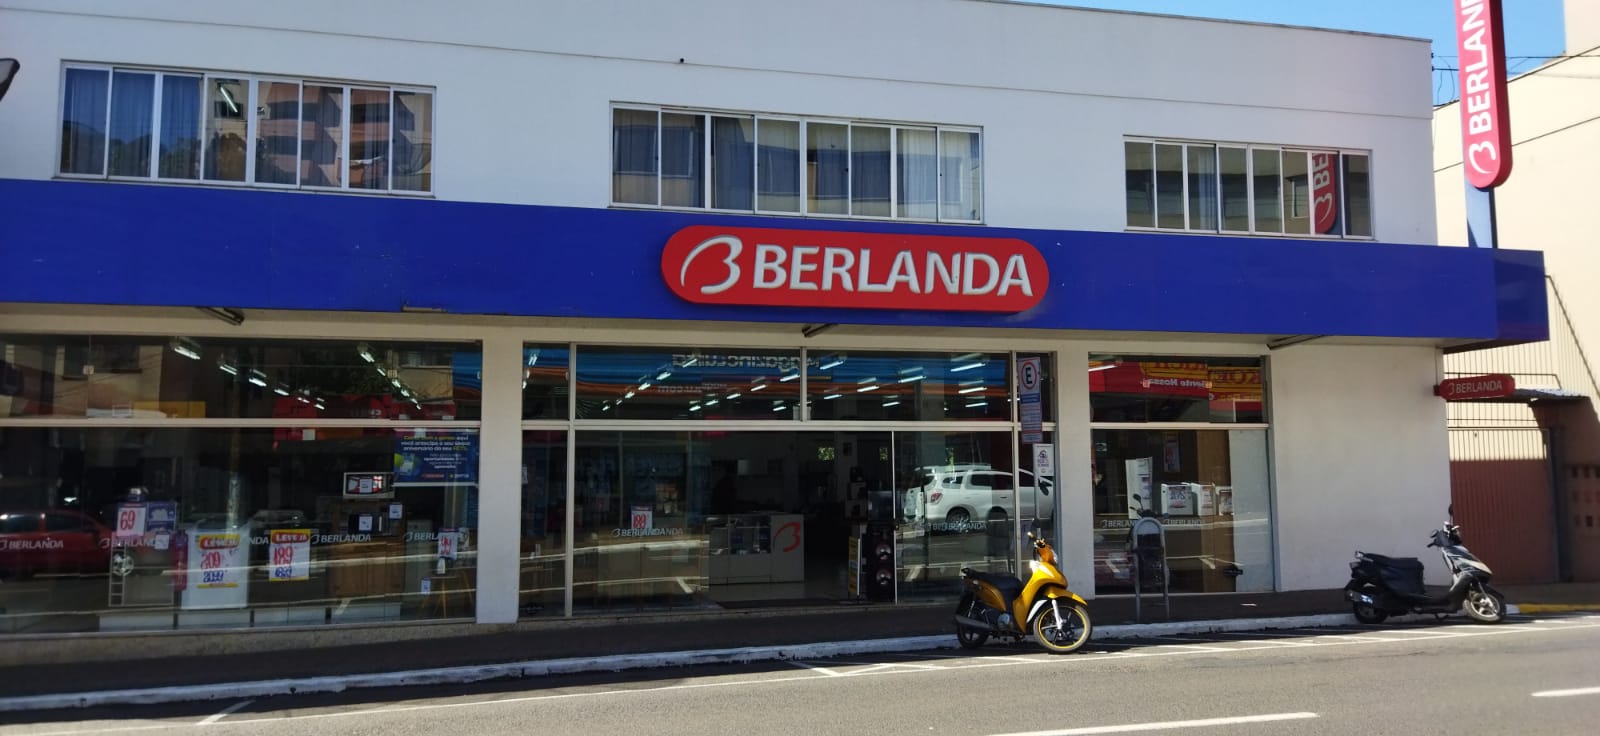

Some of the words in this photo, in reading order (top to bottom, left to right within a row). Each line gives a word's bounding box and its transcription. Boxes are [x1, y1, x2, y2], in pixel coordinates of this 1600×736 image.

[752, 242, 1034, 297] BERLANDA
[1025, 367, 1033, 385] E
[1456, 380, 1503, 394] BERLANDA
[120, 510, 136, 531] 69
[9, 539, 64, 551] BERLANDA
[321, 533, 371, 544] BERLANDA
